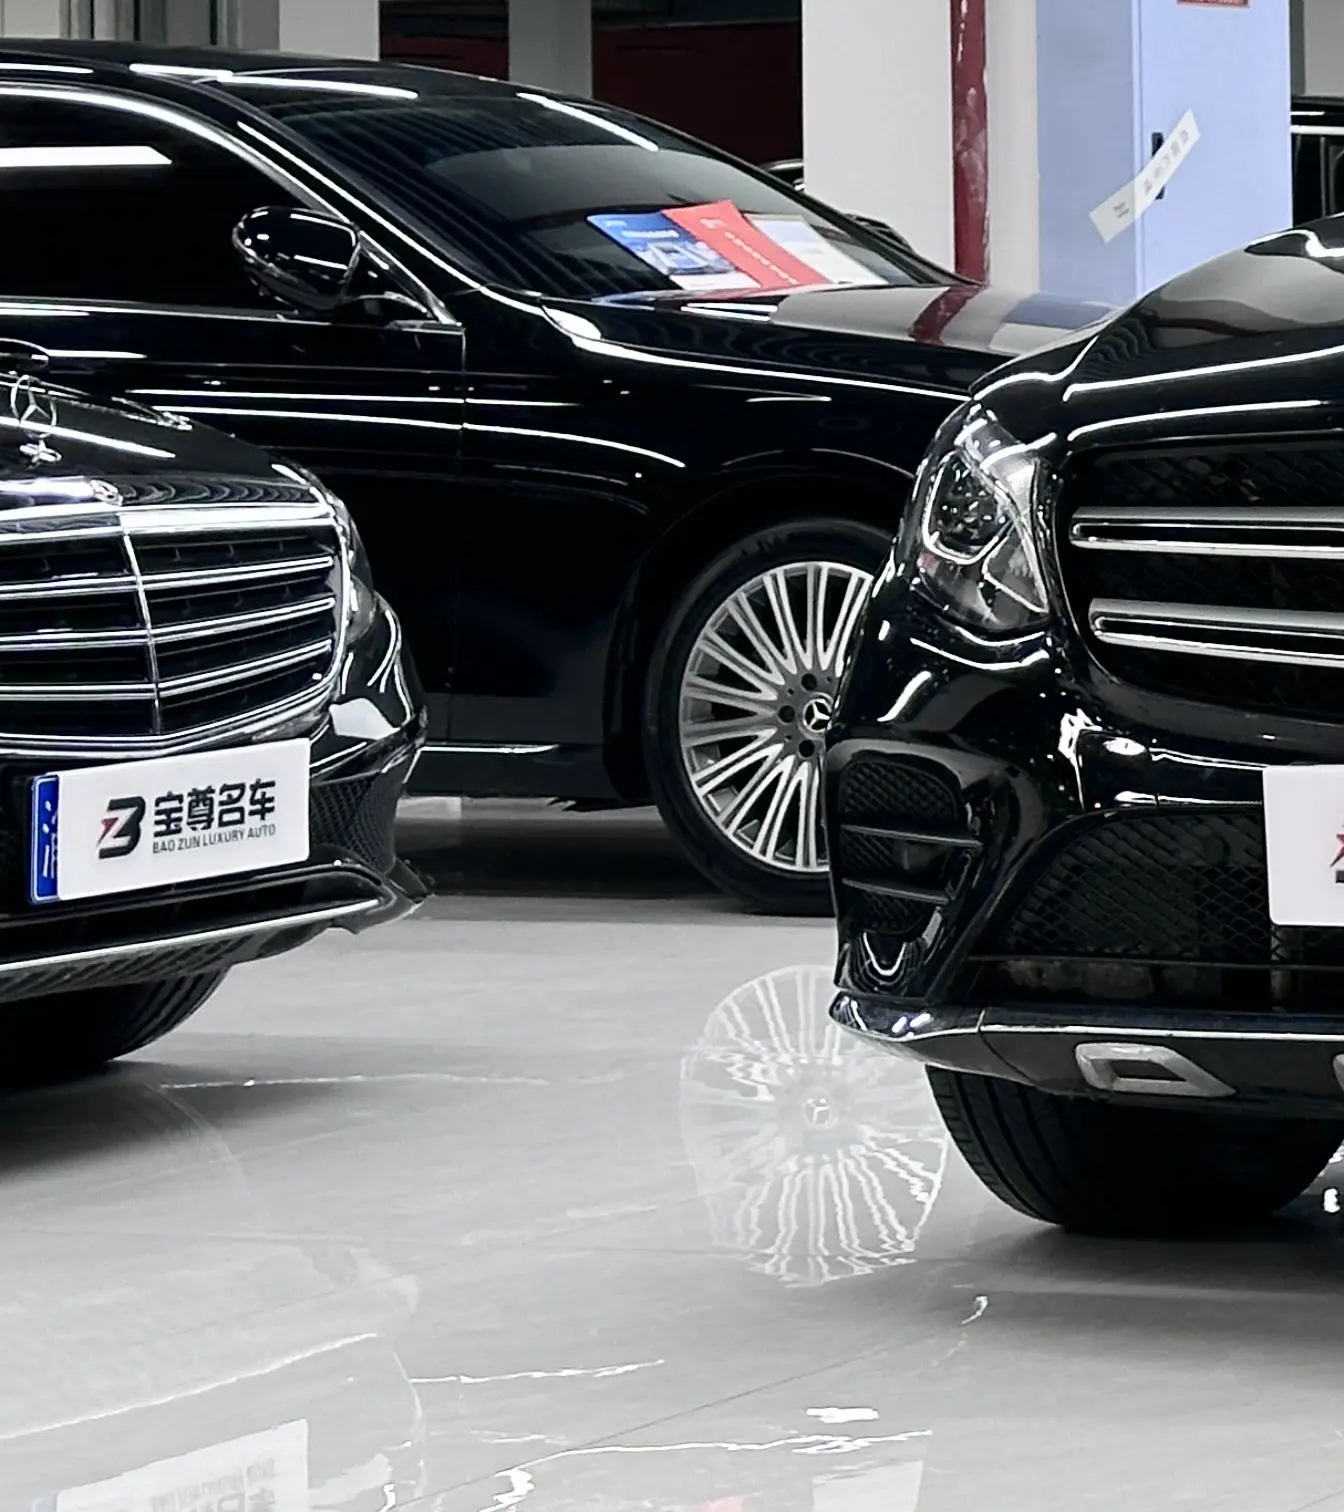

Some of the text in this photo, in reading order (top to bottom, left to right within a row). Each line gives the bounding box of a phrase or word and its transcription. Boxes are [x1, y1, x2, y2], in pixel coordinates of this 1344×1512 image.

[153, 778, 276, 838] 宝尊名车
[152, 823, 276, 854] BAO ZUN LUXURY AUTO
